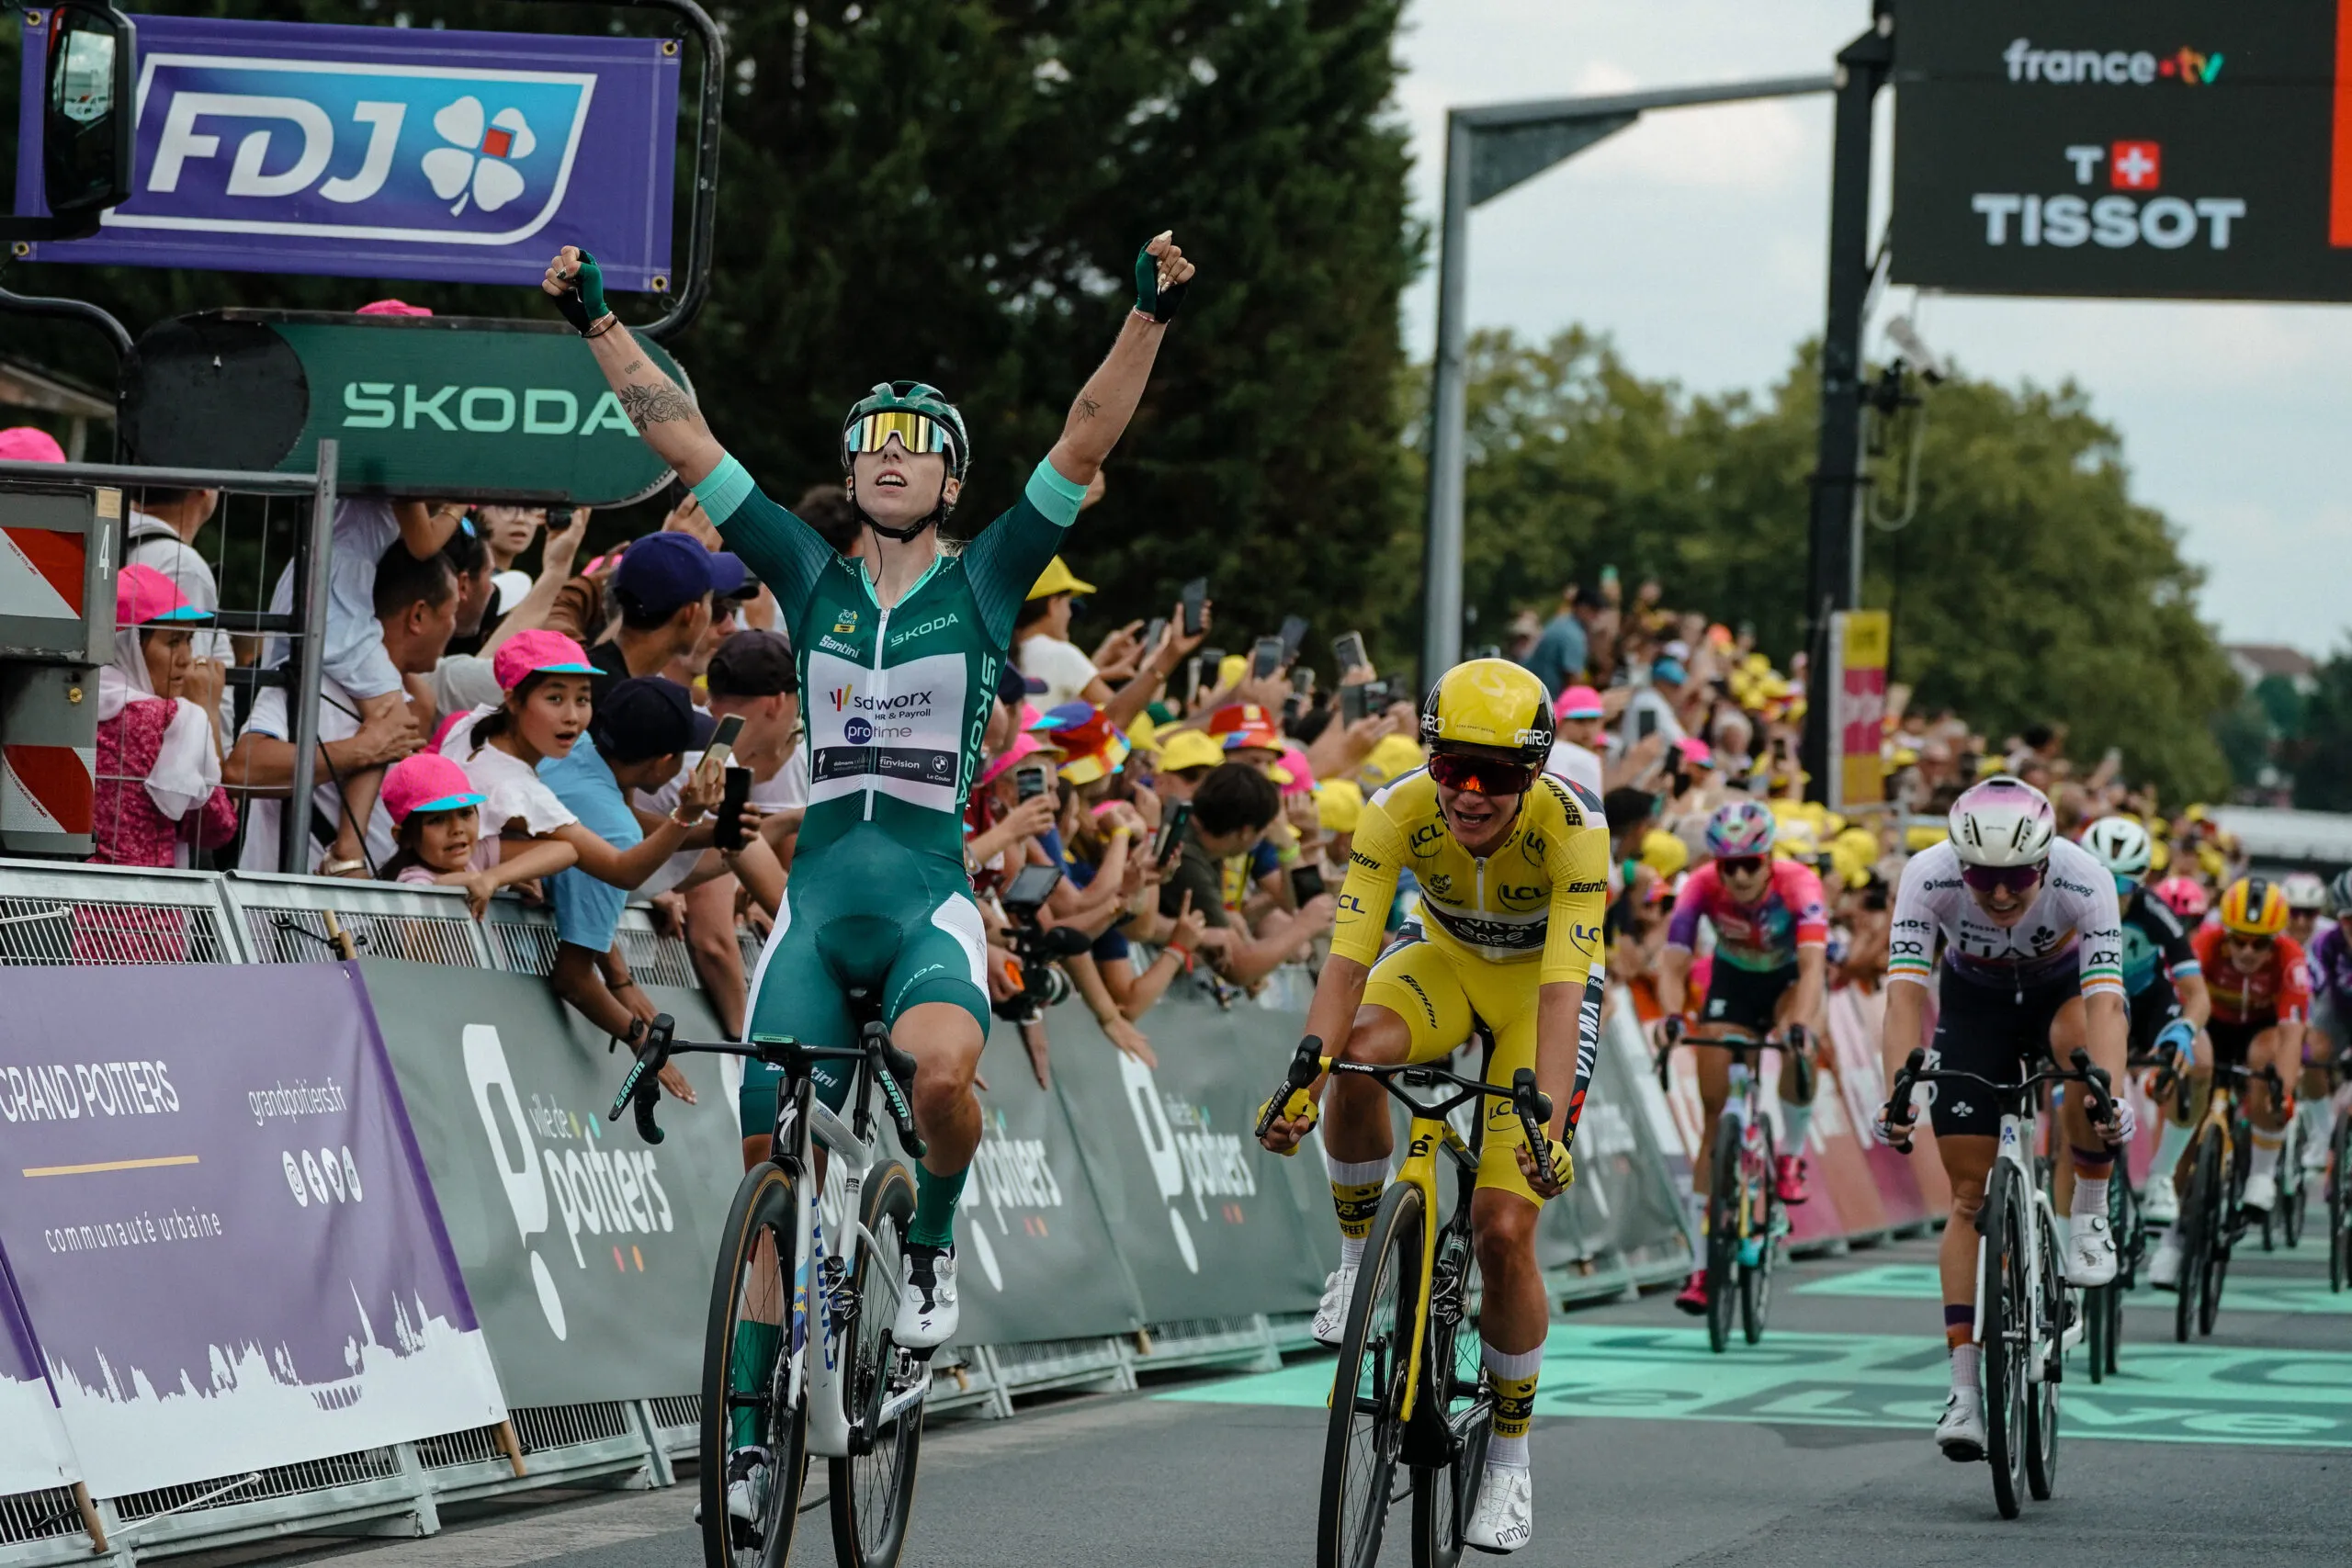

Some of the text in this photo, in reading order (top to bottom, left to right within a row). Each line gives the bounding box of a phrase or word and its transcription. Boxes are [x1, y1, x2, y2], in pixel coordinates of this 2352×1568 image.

[147, 91, 407, 203] FDJ
[1972, 193, 2246, 250] TISSOT
[819, 635, 860, 659] Santini
[899, 709, 931, 719] Payroll
[848, 725, 912, 739] protime
[1514, 728, 1552, 746] GIRO
[880, 758, 920, 769] finvision
[1411, 823, 1443, 848] LCL
[1350, 849, 1381, 870] ntini
[1338, 894, 1366, 914] CL
[1503, 885, 1551, 900] LCL
[1576, 925, 1600, 942] LC
[1576, 999, 1600, 1080] VISMA
[74, 1060, 180, 1118] POITIERS
[615, 1061, 645, 1108] SRAM
[879, 1070, 908, 1118] SRAM
[247, 1077, 347, 1127] grandpoitiers.fr
[1527, 1118, 1549, 1168] SRAM
[543, 1125, 673, 1269] poitiers
[44, 1207, 222, 1254] communauté urbaine
[1465, 1407, 1488, 1431] SRAM
[1495, 1520, 1530, 1546] nimbl
